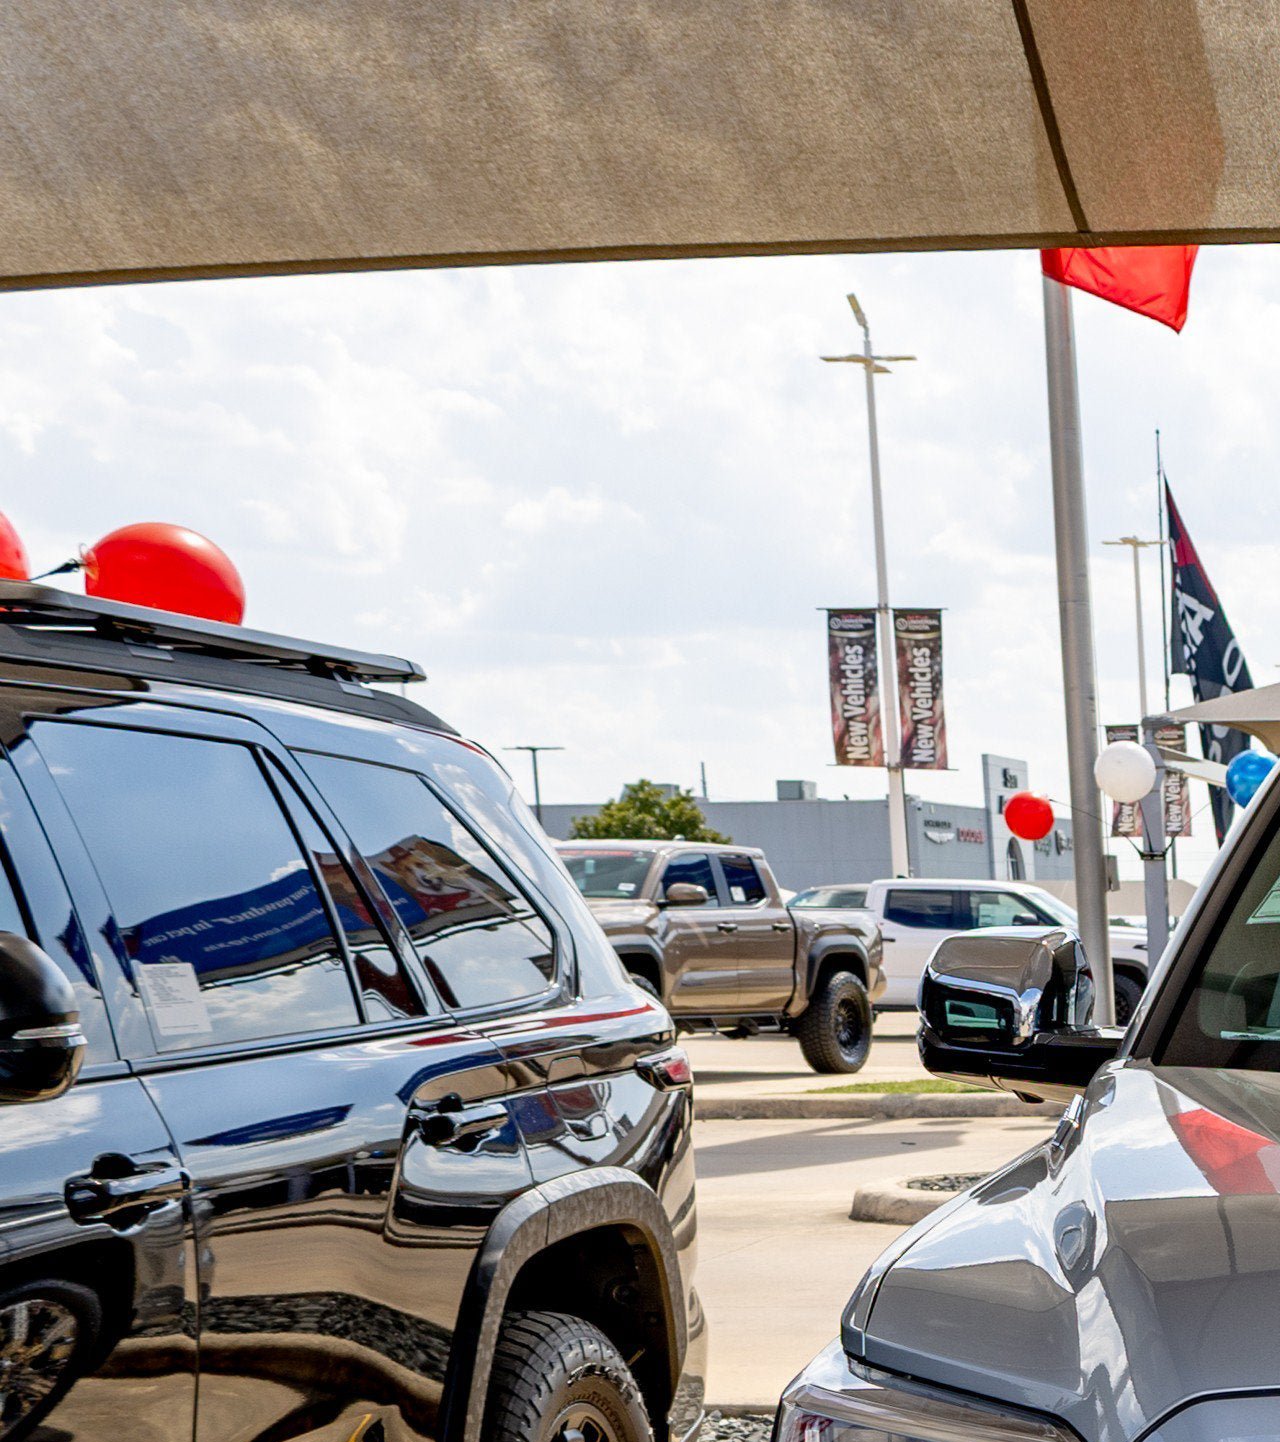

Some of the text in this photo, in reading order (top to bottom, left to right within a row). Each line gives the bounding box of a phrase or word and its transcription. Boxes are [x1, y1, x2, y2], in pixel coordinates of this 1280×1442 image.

[841, 644, 865, 718] Vehicles
[909, 647, 933, 720] Vehicles
[846, 721, 870, 760] New
[912, 723, 935, 762] New
[1118, 803, 1134, 832] New
[1166, 806, 1183, 832] New
